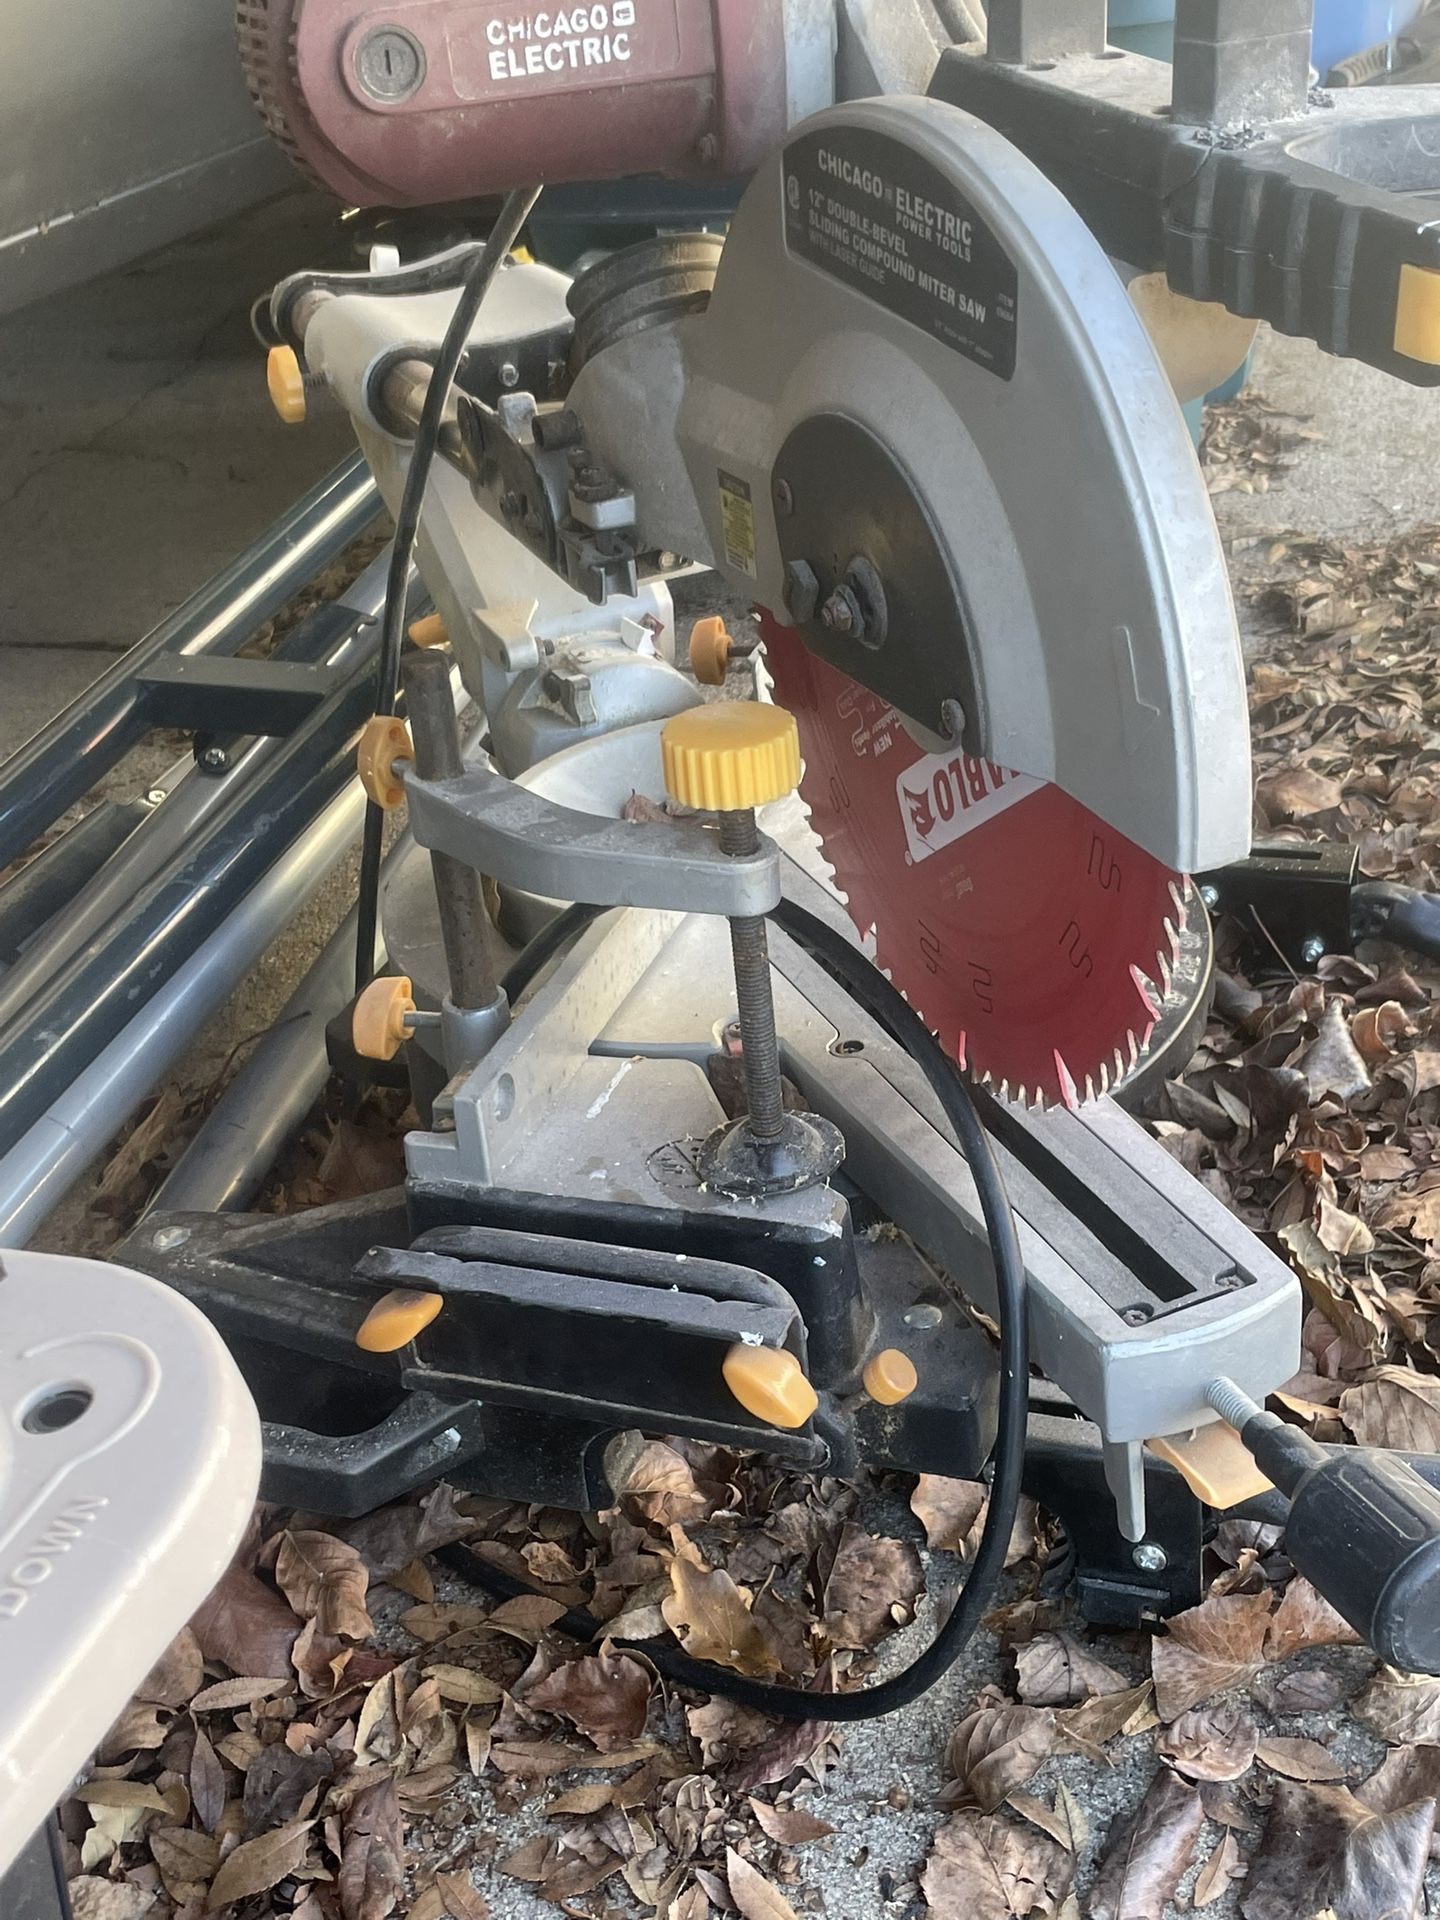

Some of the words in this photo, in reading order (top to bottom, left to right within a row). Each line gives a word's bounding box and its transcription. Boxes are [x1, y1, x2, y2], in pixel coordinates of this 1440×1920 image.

[487, 4, 608, 45] CHICAGO
[488, 33, 631, 80] ELECTRIC
[818, 148, 883, 199] CHICAGO
[896, 187, 972, 246] ELECTRIC
[827, 198, 909, 257] DOUBLE-BEVEL
[895, 211, 932, 242] POWER
[936, 232, 971, 263] TOOLS
[808, 208, 850, 246] SLIDING
[852, 234, 915, 283] COMPOUND
[918, 270, 956, 307] MITER
[959, 293, 986, 324] SAW
[830, 240, 857, 268] LASER
[859, 258, 885, 285] GUIDE
[873, 732, 893, 757] NEW
[0, 1493, 109, 1617] DOWN
